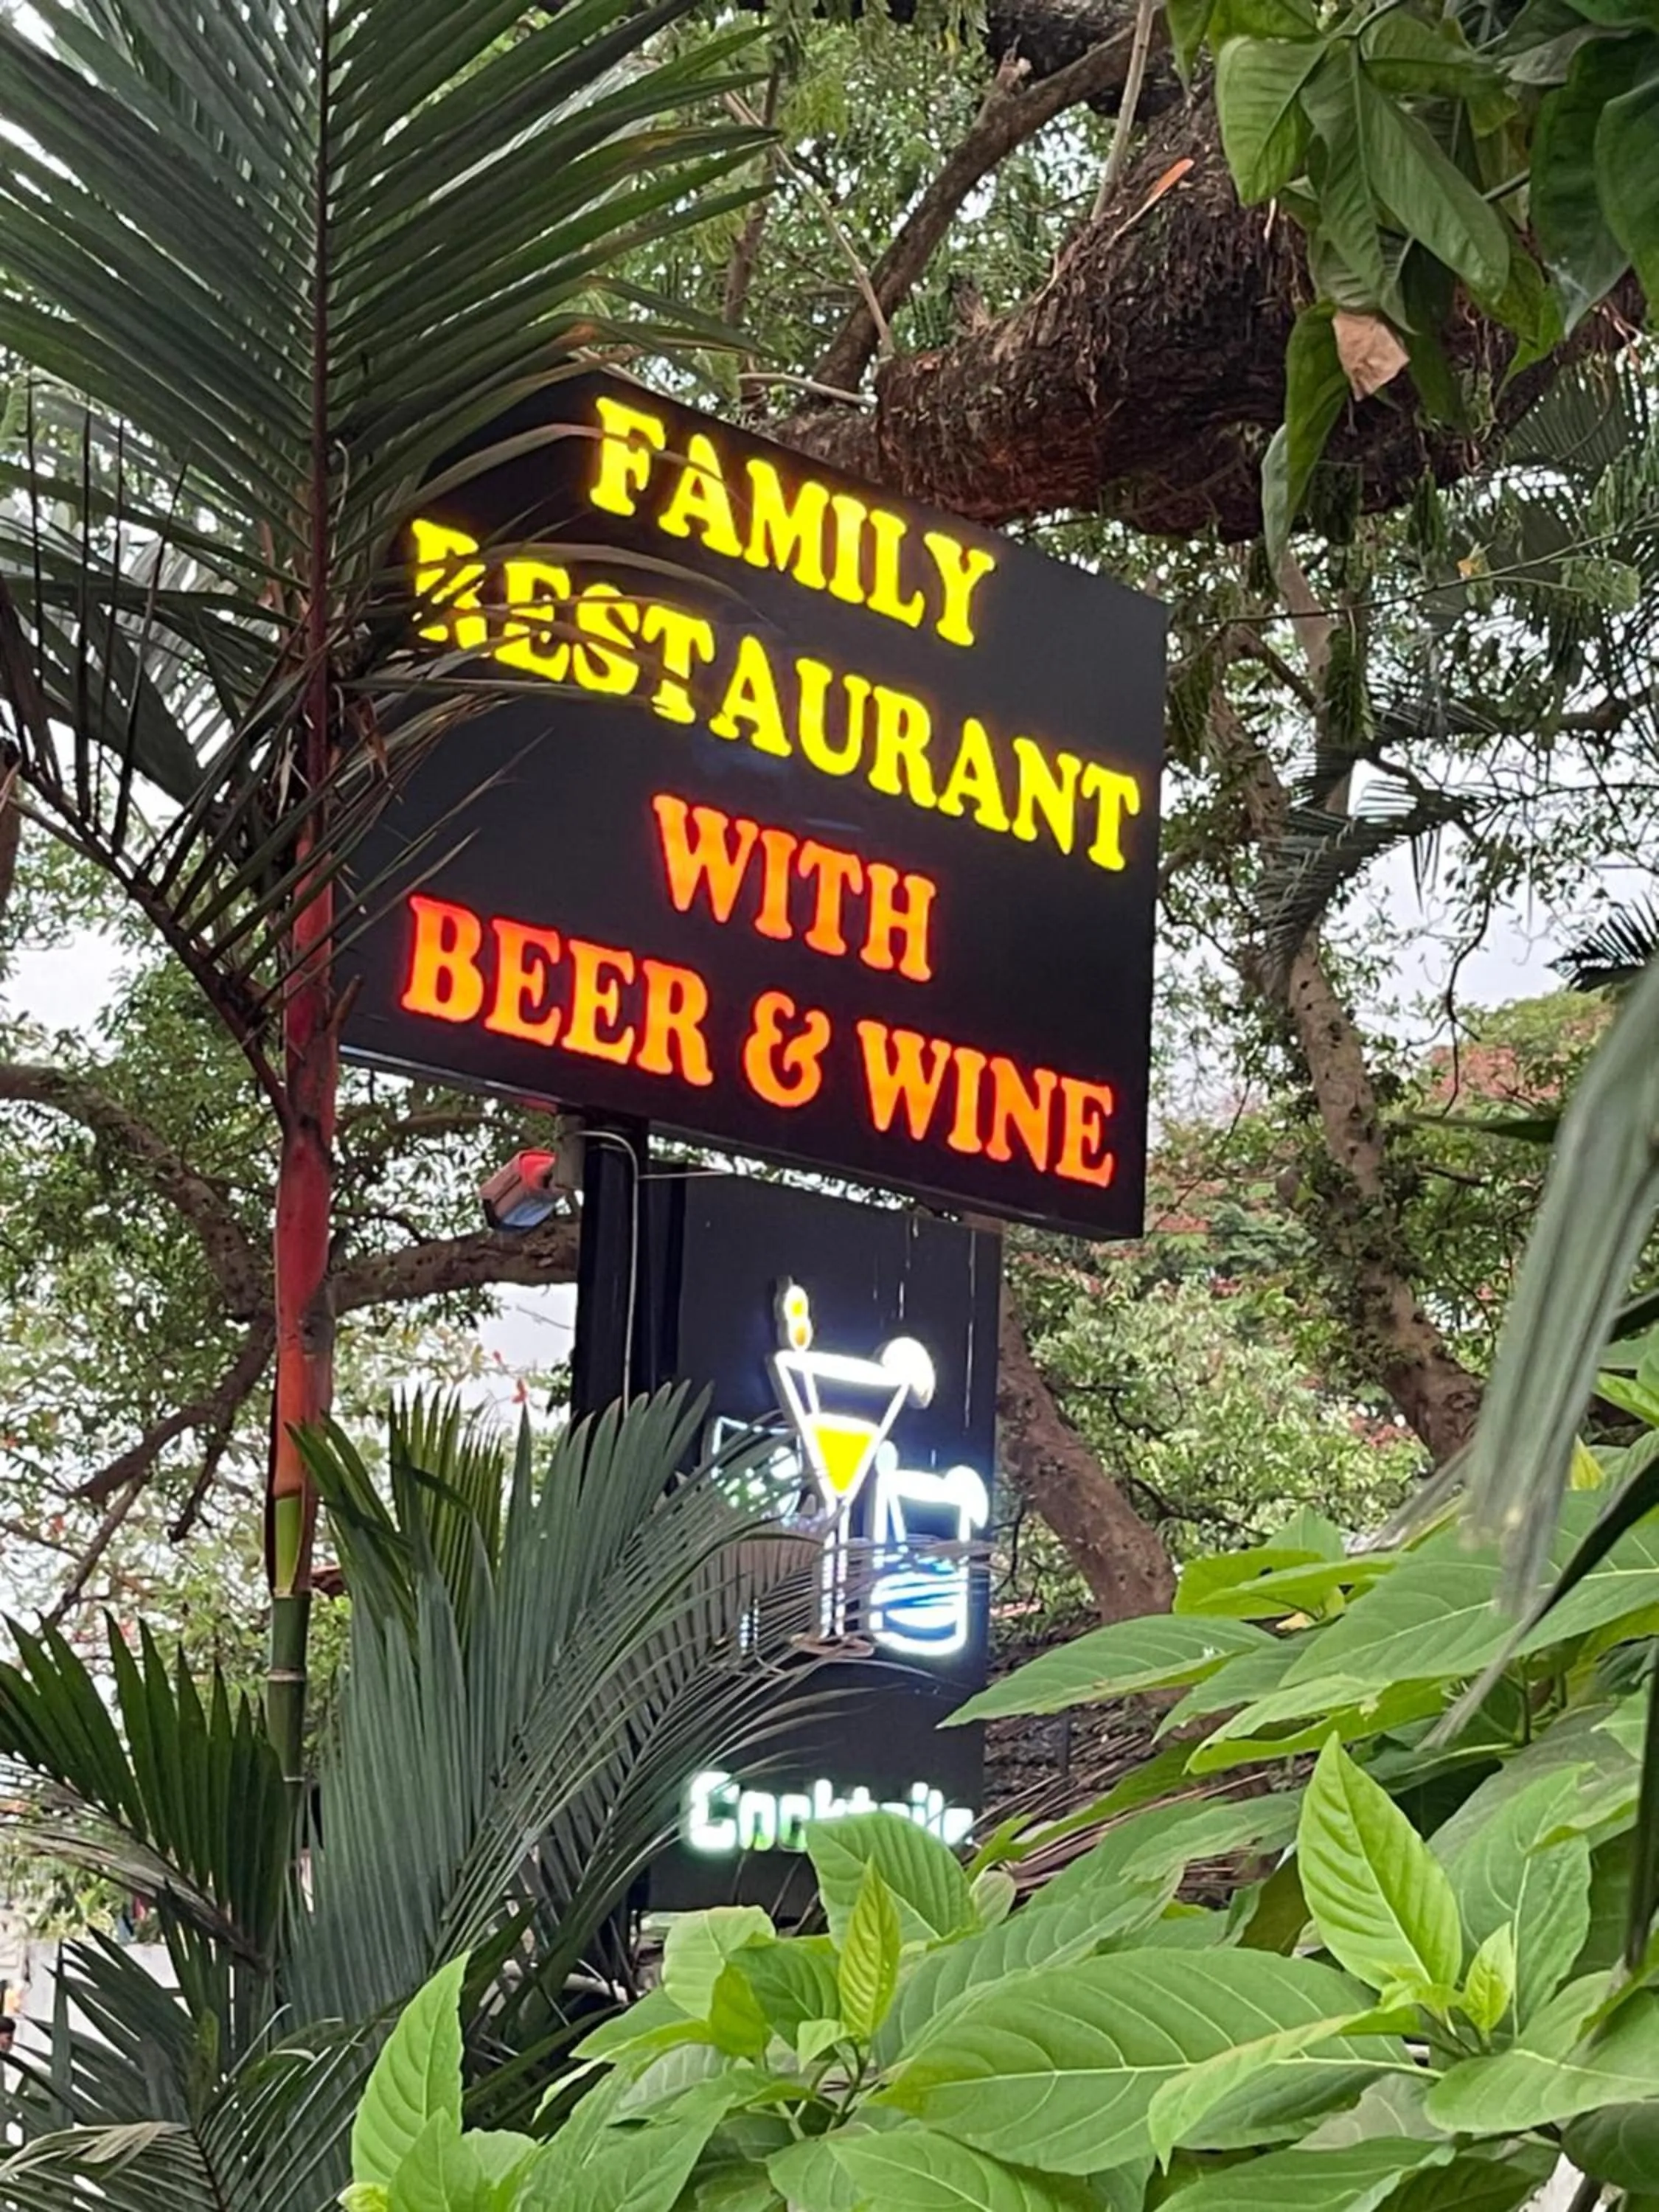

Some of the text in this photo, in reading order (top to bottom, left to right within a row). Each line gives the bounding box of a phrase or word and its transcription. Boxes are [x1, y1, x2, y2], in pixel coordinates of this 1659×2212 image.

[590, 397, 995, 647] FAMILY
[411, 519, 1141, 871] RESTAURANT
[652, 794, 937, 982] WITH
[401, 895, 1115, 1186] BEER & WINE
[689, 1771, 973, 1852] Cockils
